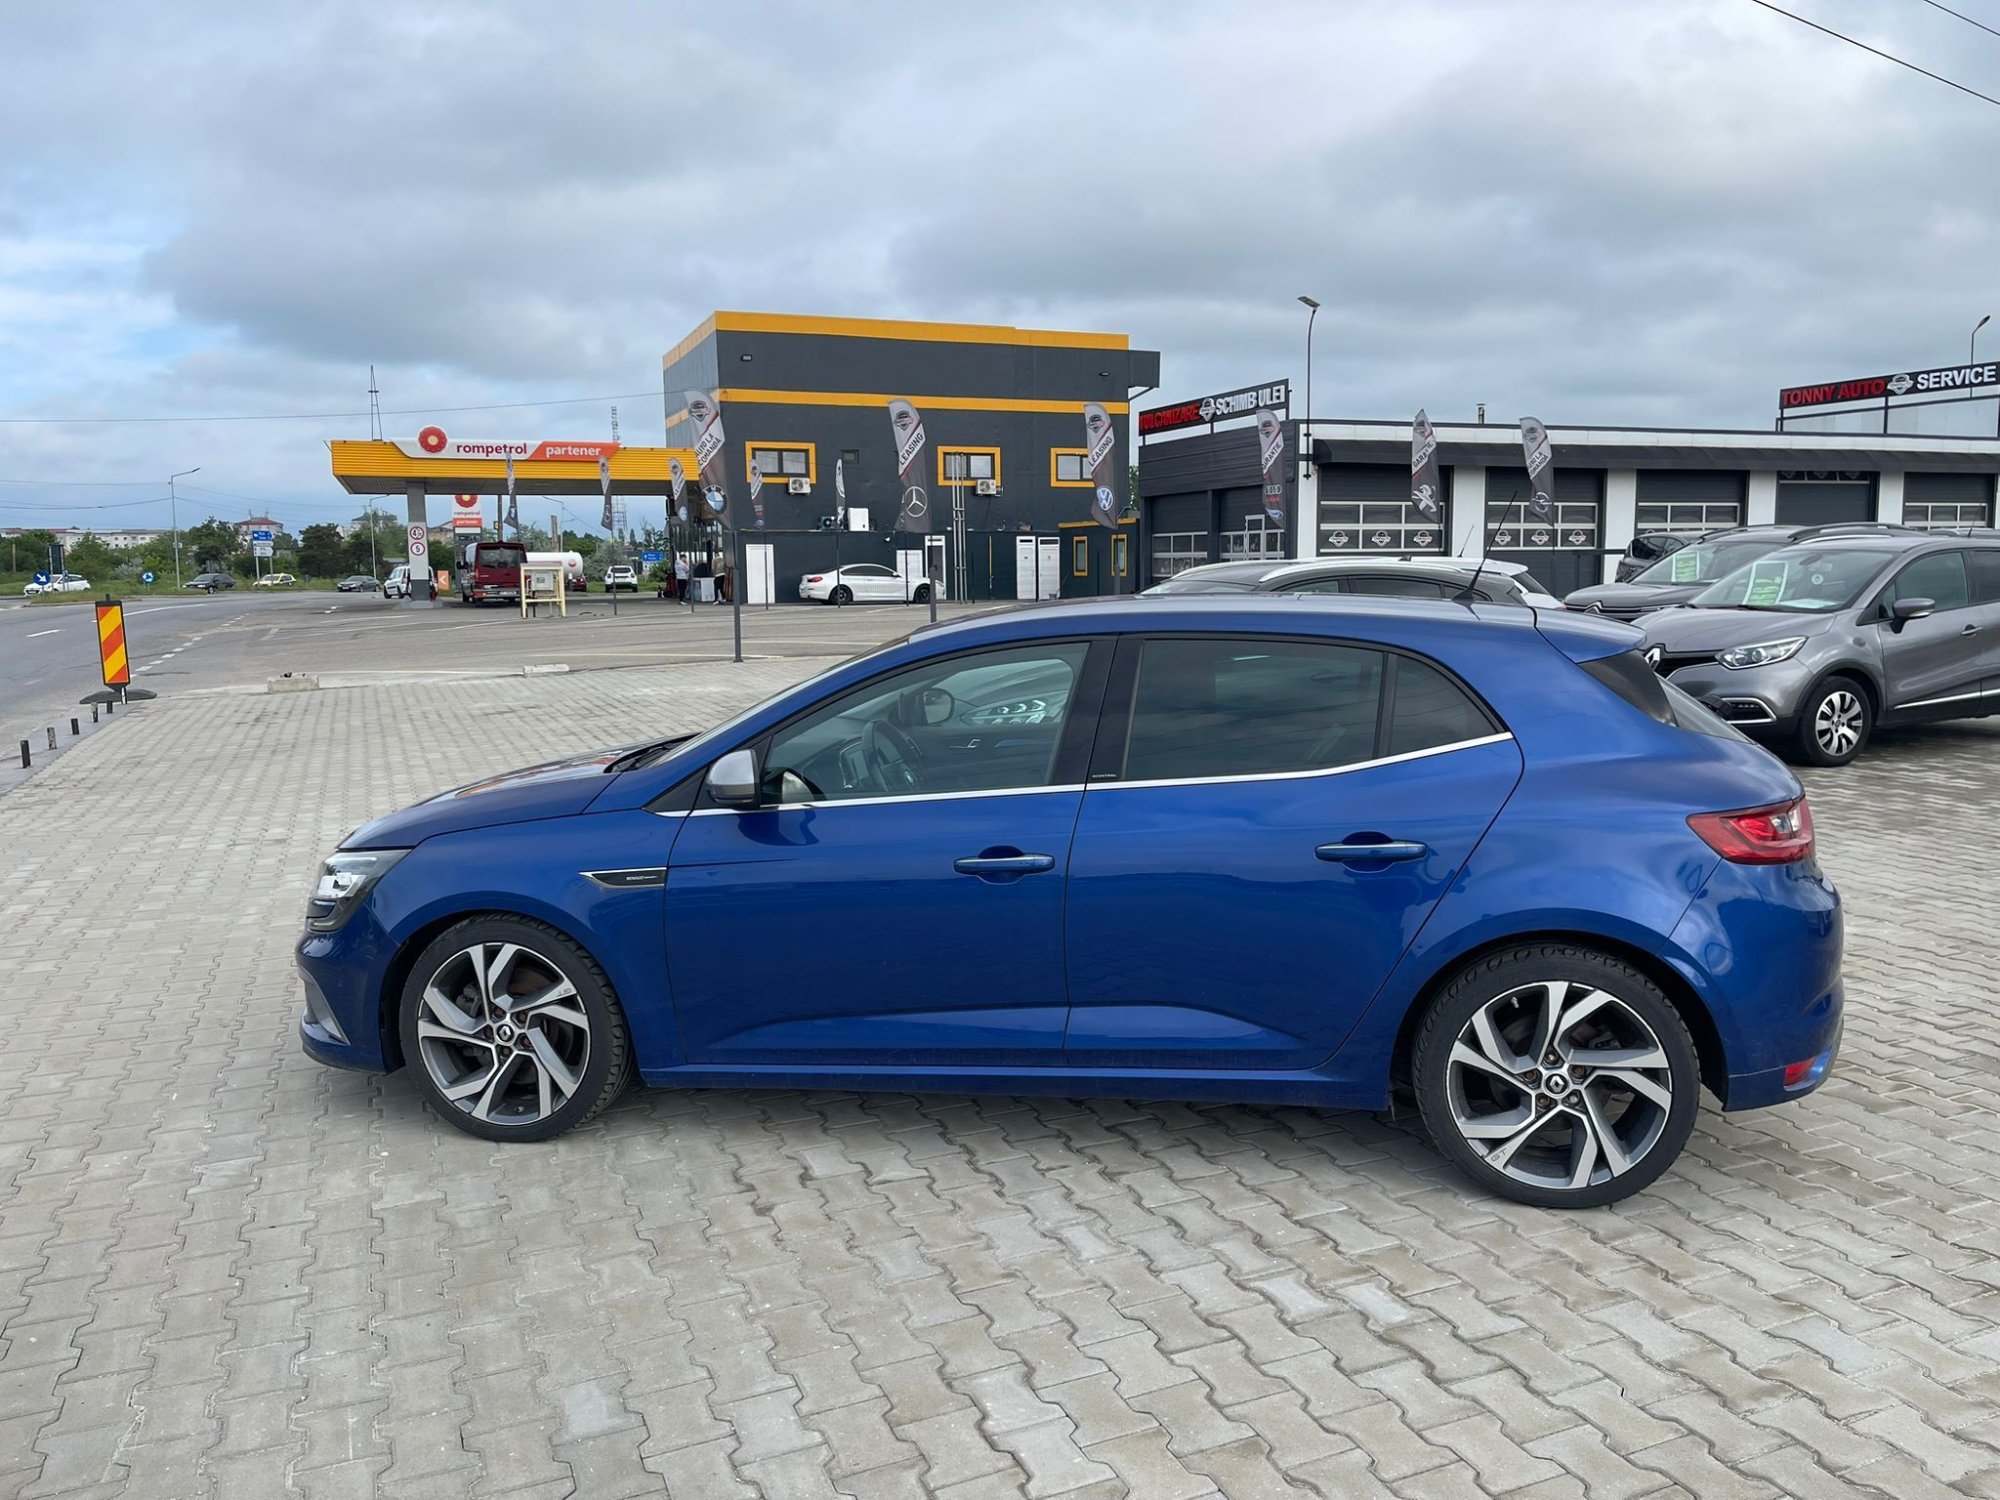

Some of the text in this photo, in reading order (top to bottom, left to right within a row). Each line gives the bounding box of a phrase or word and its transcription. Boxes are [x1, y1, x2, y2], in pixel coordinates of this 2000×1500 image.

[1216, 391, 1257, 415] SCHIMB
[1258, 385, 1286, 407] ULEI
[1782, 385, 1835, 406] TONNY
[1838, 378, 1886, 398] AUTO
[1917, 365, 1997, 390] SERVICE
[456, 442, 527, 457] rompetrol
[546, 444, 601, 458] partener
[698, 437, 721, 466] COMANDA
[900, 432, 924, 466] LEASING
[1088, 436, 1113, 467] LEASING
[1490, 1147, 1507, 1162] GT
